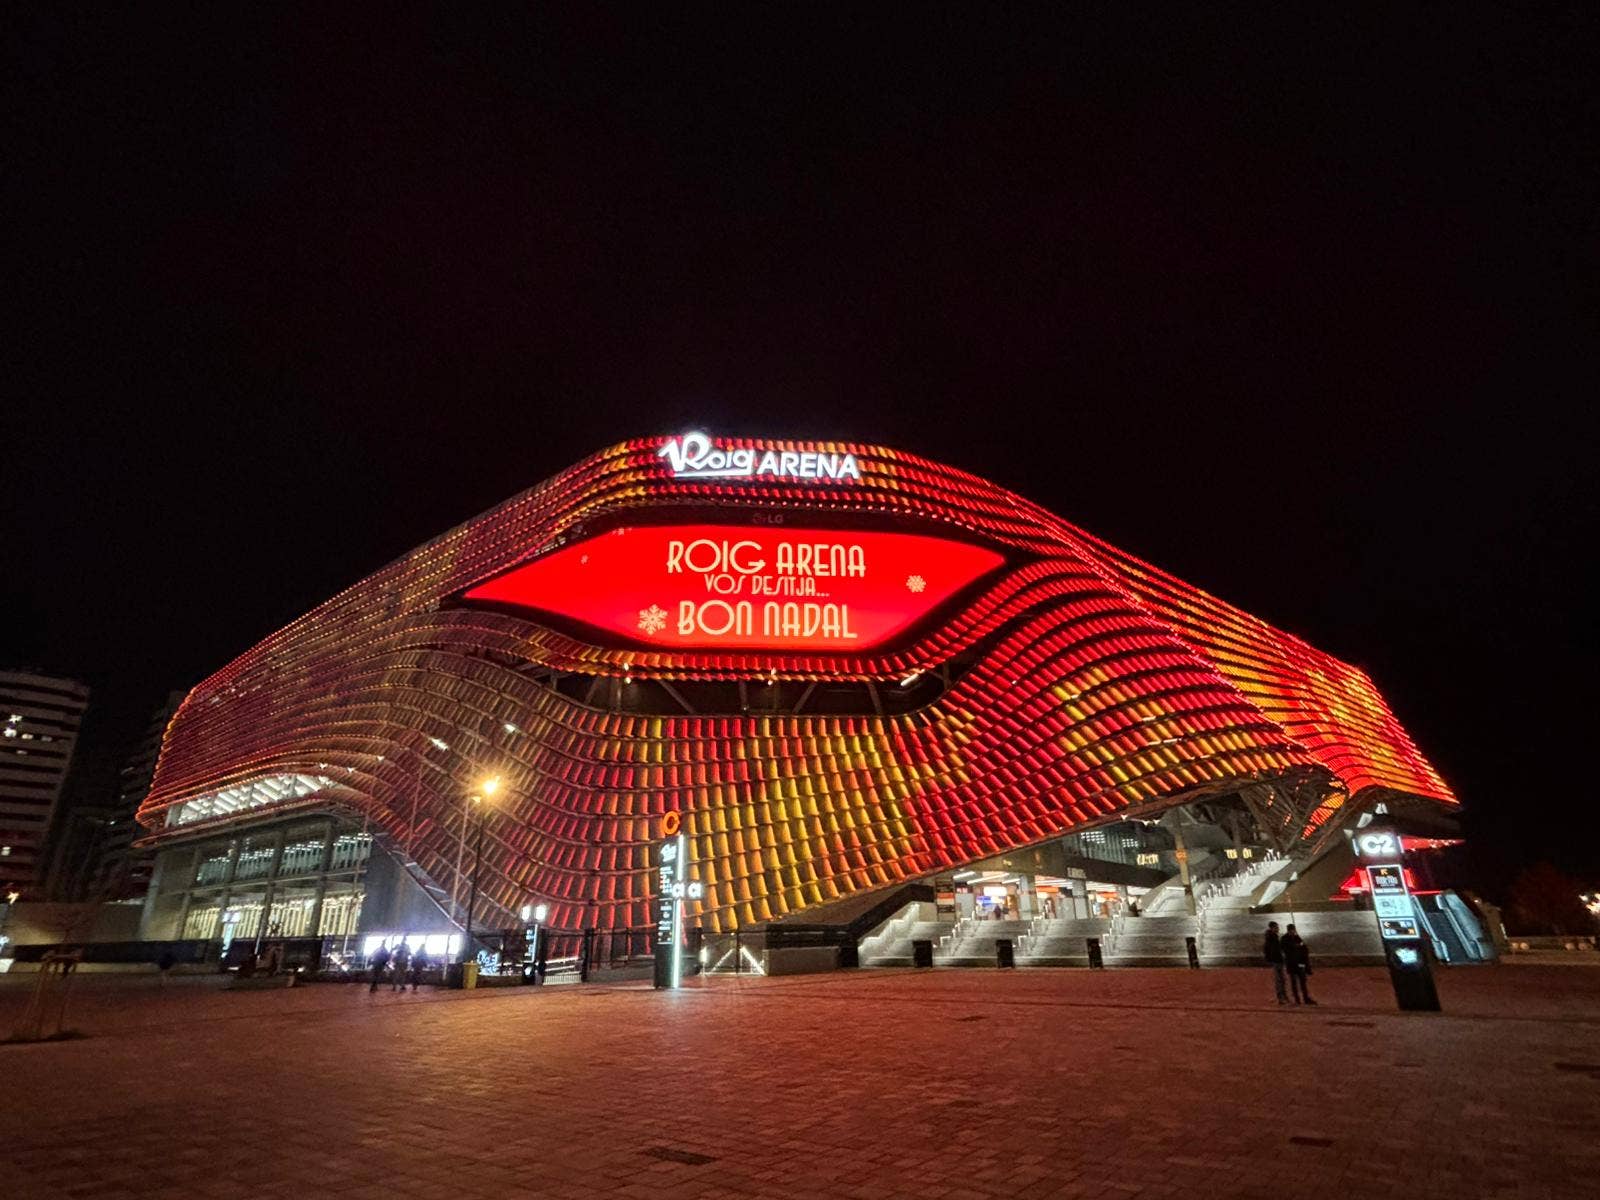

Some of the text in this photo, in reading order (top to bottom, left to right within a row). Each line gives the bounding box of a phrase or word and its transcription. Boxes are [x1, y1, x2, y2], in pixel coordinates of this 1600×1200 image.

[658, 433, 861, 479] Roig ARENA
[767, 514, 784, 524] LG
[666, 539, 866, 577] ROIG ARENA
[704, 574, 746, 594] VOS
[677, 600, 858, 638] BON NADAL
[1361, 834, 1395, 854] C2
